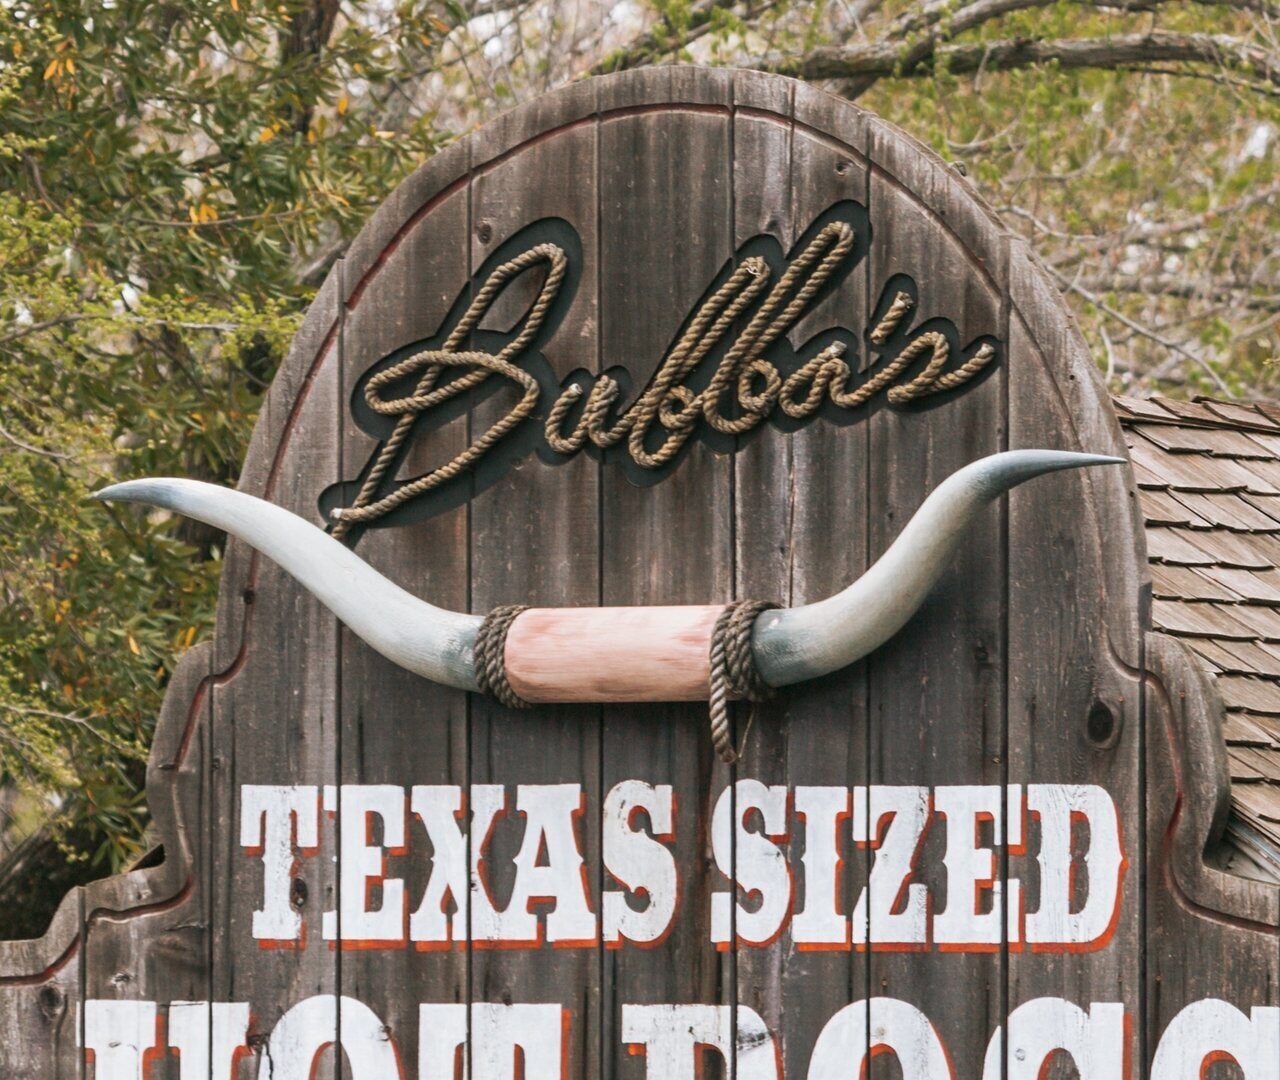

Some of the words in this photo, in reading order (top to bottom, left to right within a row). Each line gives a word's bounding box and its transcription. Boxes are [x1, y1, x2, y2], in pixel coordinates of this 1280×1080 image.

[330, 220, 996, 540] Bubba's
[240, 778, 681, 950] TEXAS
[709, 778, 1129, 952] SIZED
